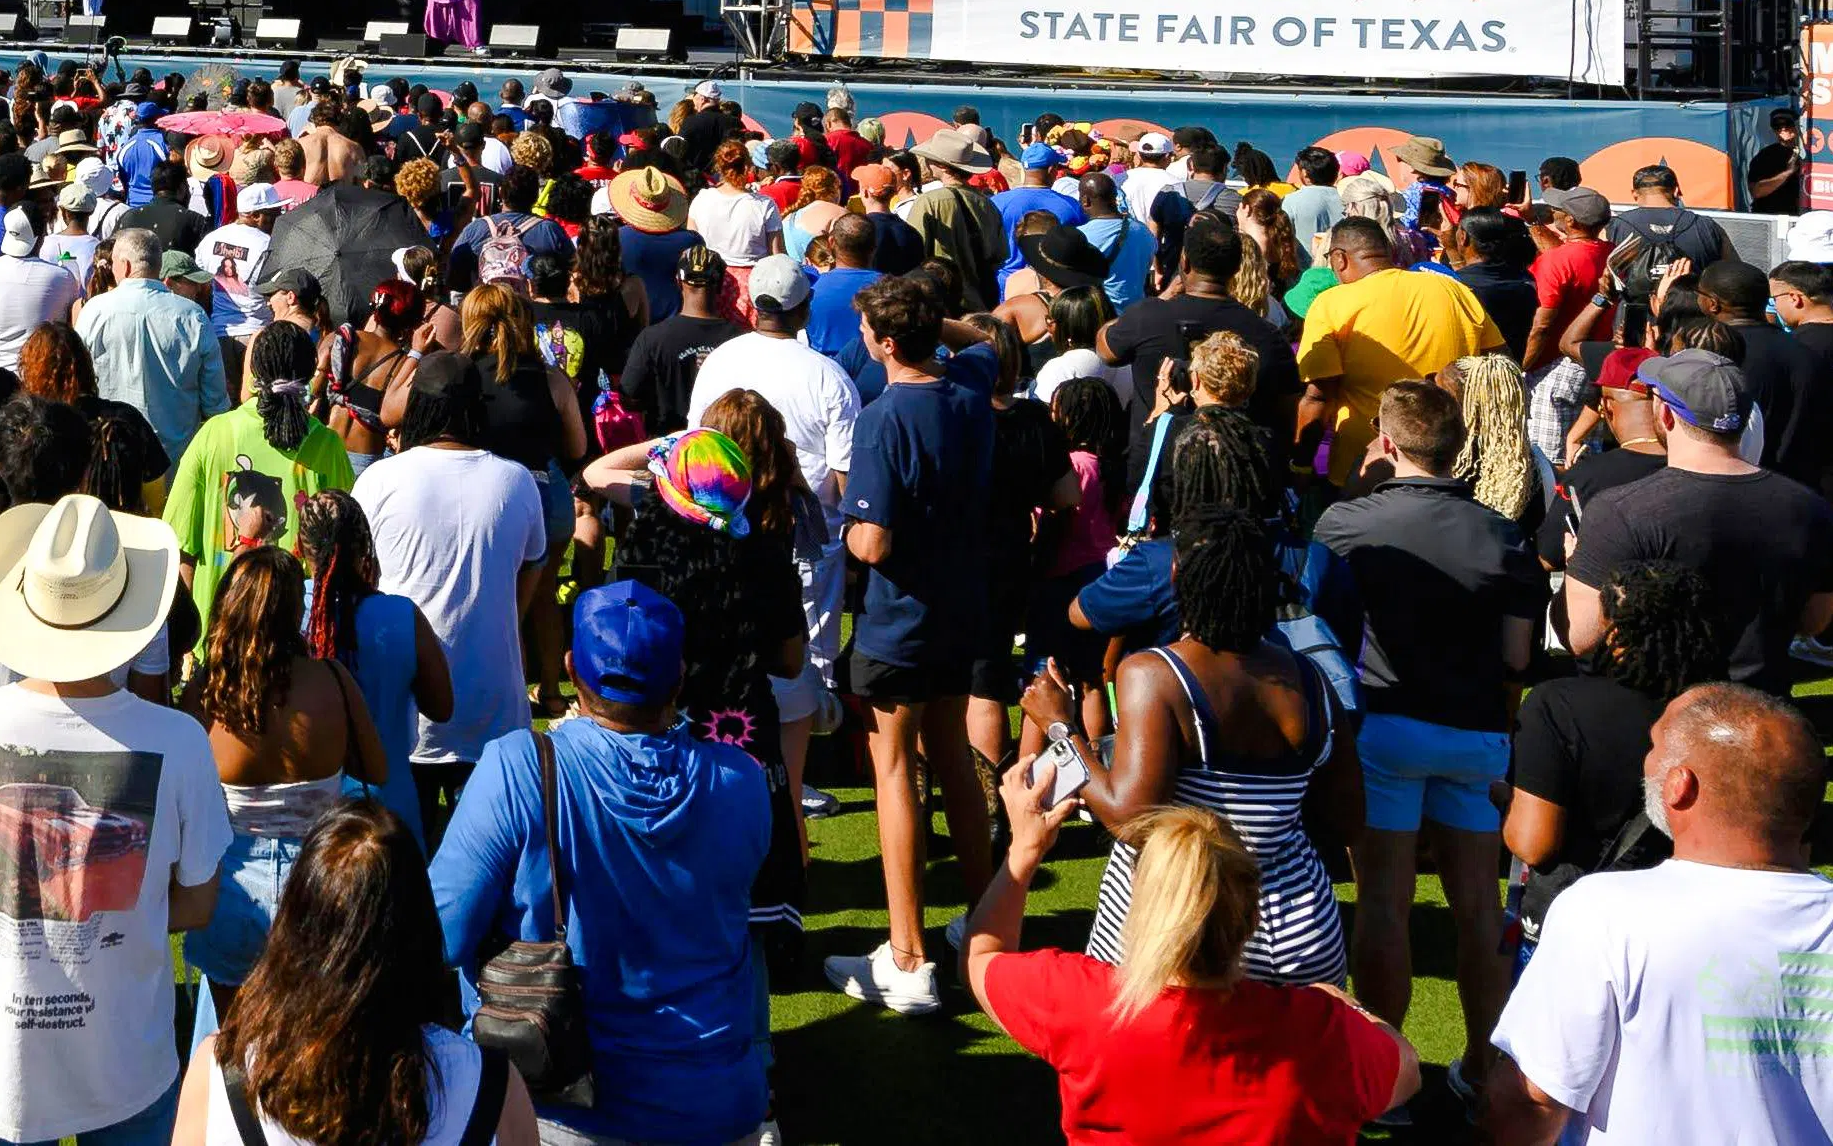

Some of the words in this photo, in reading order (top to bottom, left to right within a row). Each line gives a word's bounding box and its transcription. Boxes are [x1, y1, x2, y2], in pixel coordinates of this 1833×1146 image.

[1019, 11, 1139, 41] STATE
[1156, 14, 1254, 46] FAIR
[1291, 16, 1336, 48] OF
[1352, 17, 1507, 52] TEXAS
[12, 993, 22, 1003] In
[24, 994, 43, 1005] ten
[27, 1005, 83, 1017] resistance
[15, 1016, 86, 1029] self-destruct.
